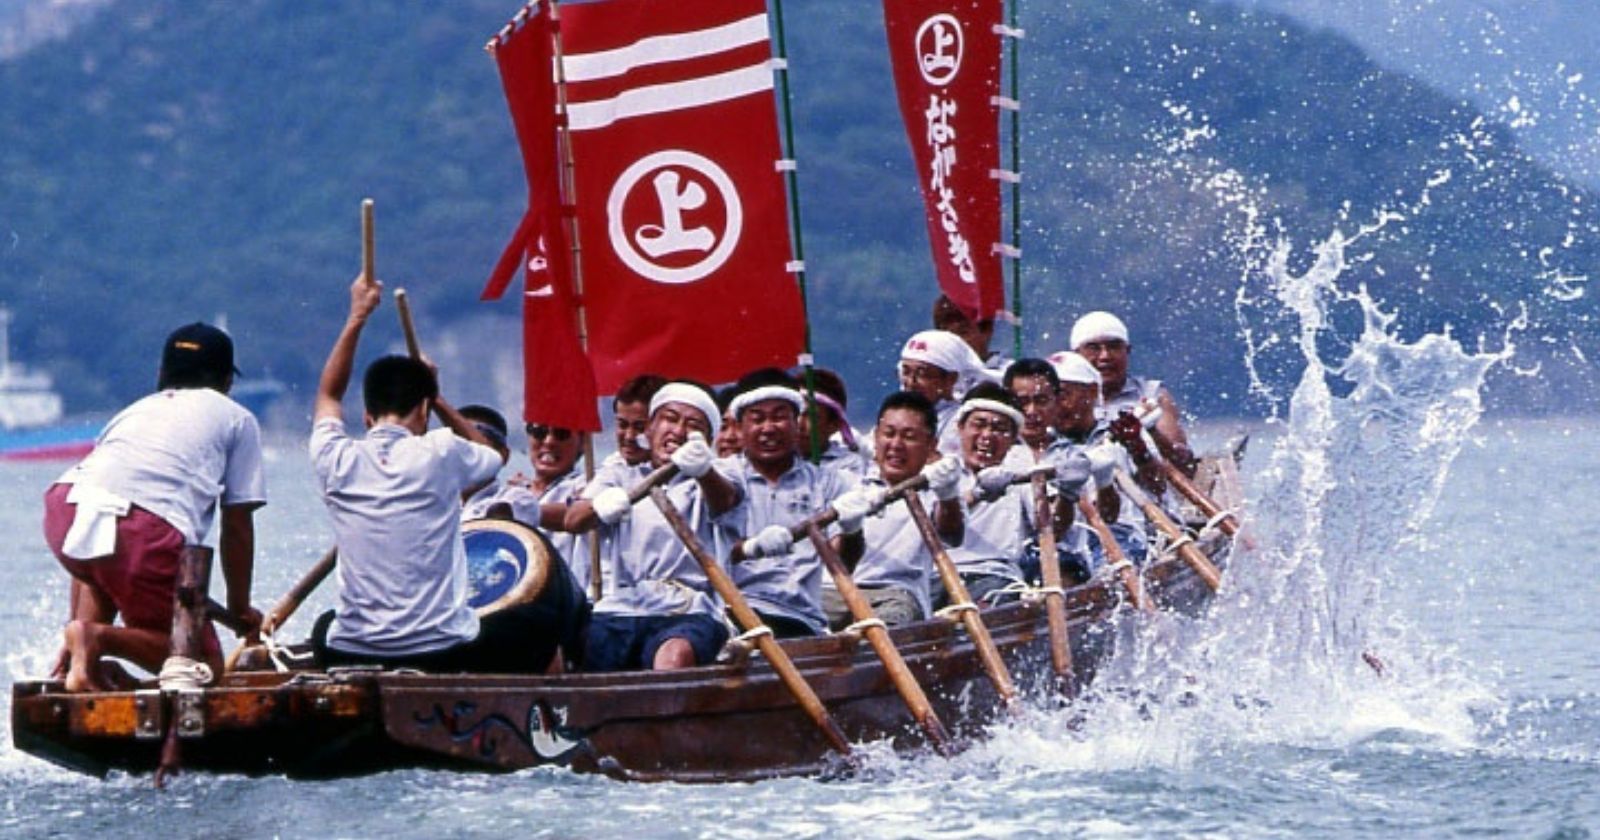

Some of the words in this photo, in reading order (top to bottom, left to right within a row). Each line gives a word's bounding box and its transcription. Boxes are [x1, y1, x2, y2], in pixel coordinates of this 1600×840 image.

[923, 22, 954, 72] 上
[635, 170, 716, 258] 上
[925, 95, 976, 283] ながさき
